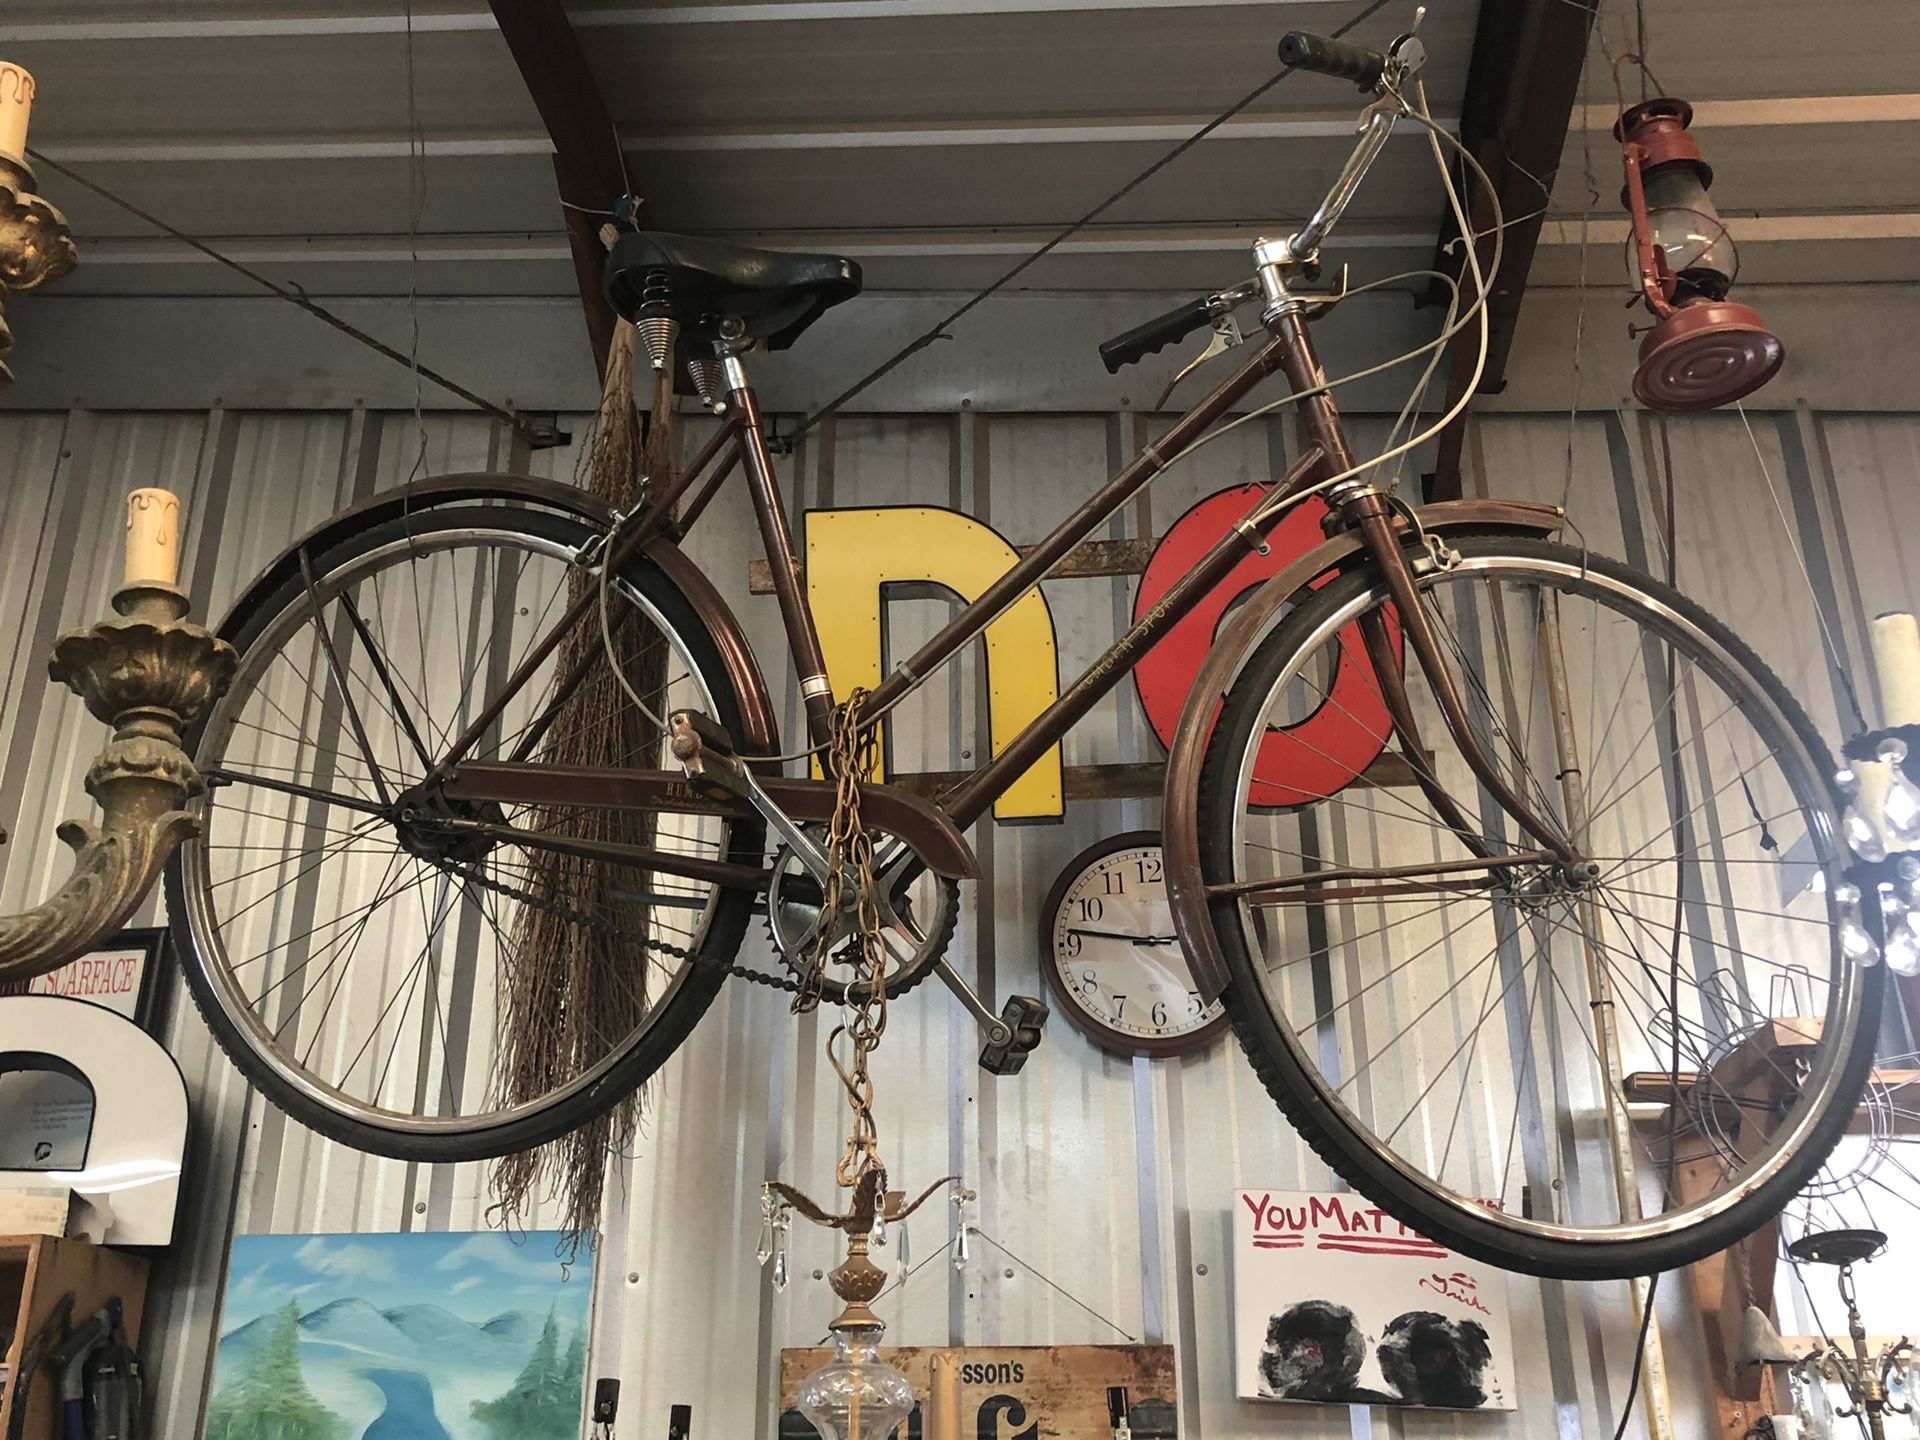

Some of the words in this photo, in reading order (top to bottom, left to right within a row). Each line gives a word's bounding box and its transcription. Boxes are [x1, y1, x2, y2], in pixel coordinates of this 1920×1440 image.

[1102, 872, 1126, 895] 11
[1134, 859, 1162, 884] 12
[1078, 897, 1103, 922] 10
[1067, 933, 1081, 957] 9
[45, 958, 137, 995] SCARFACE
[1082, 970, 1098, 994] 8
[1112, 995, 1127, 1018] 7
[1151, 1002, 1167, 1026] 6
[1187, 991, 1203, 1015] 5
